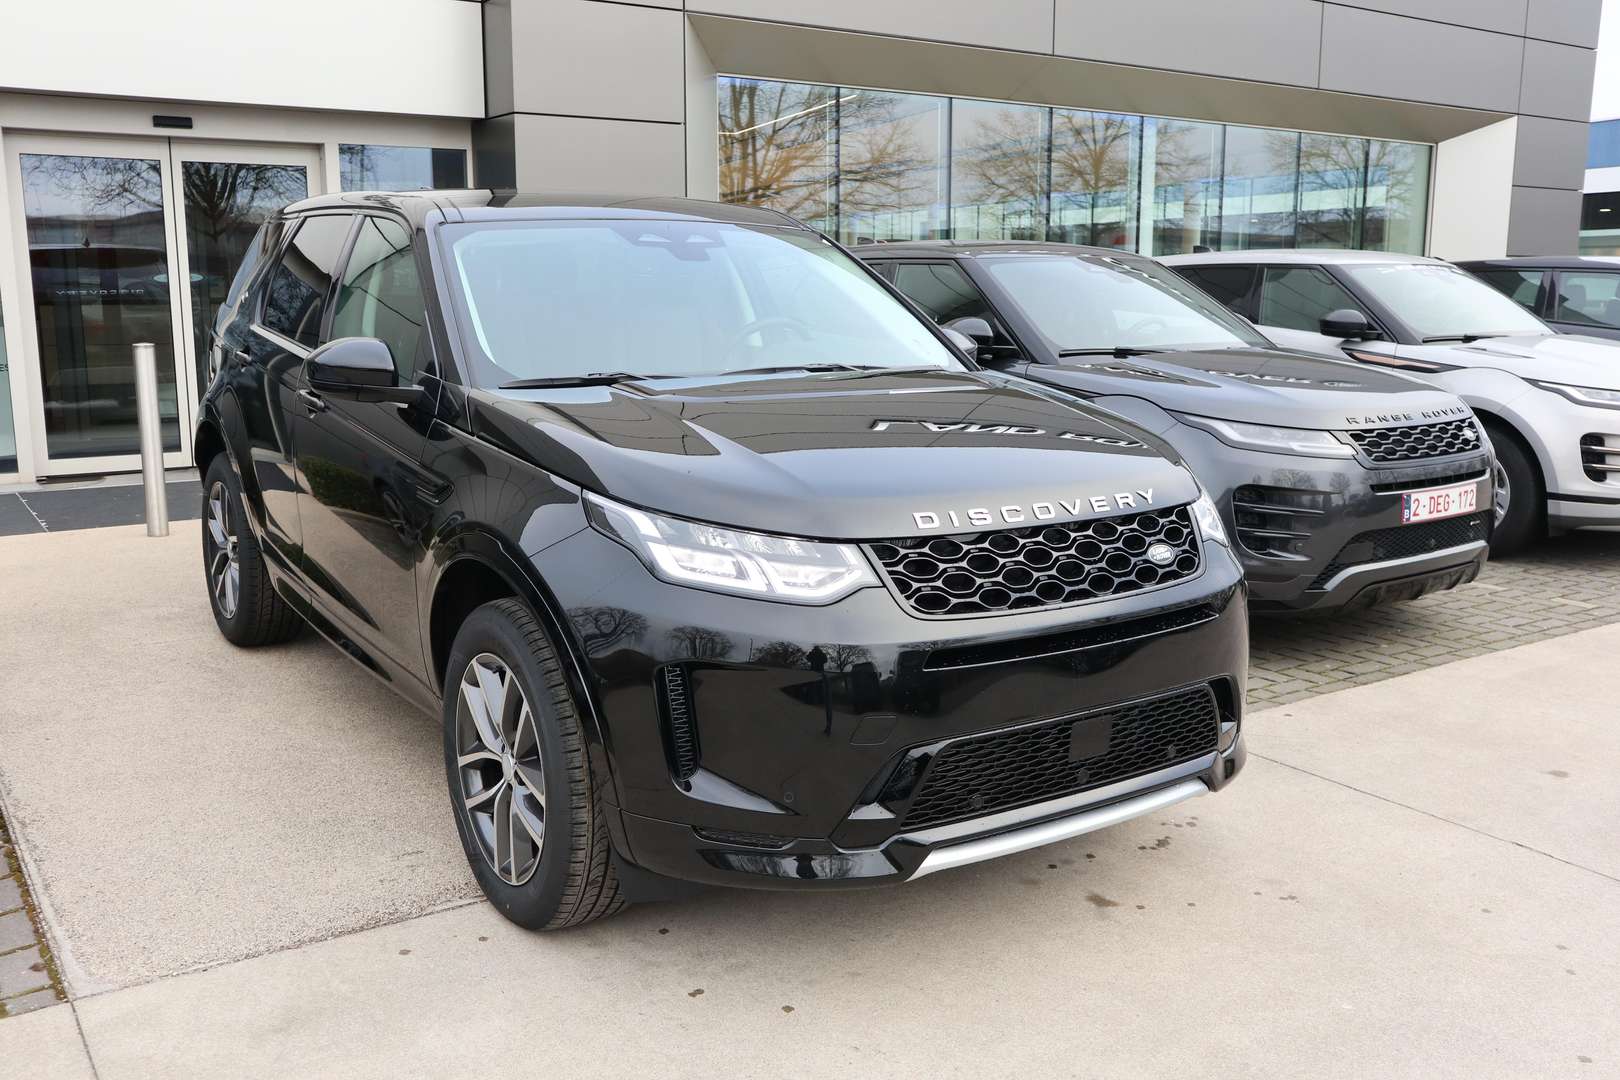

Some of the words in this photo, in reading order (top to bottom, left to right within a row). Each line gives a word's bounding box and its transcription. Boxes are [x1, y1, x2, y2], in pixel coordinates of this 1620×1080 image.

[1345, 412, 1414, 425] RANGE
[1421, 406, 1465, 419] ROVER
[911, 487, 1154, 530] DISCOVERY
[1404, 509, 1410, 518] B
